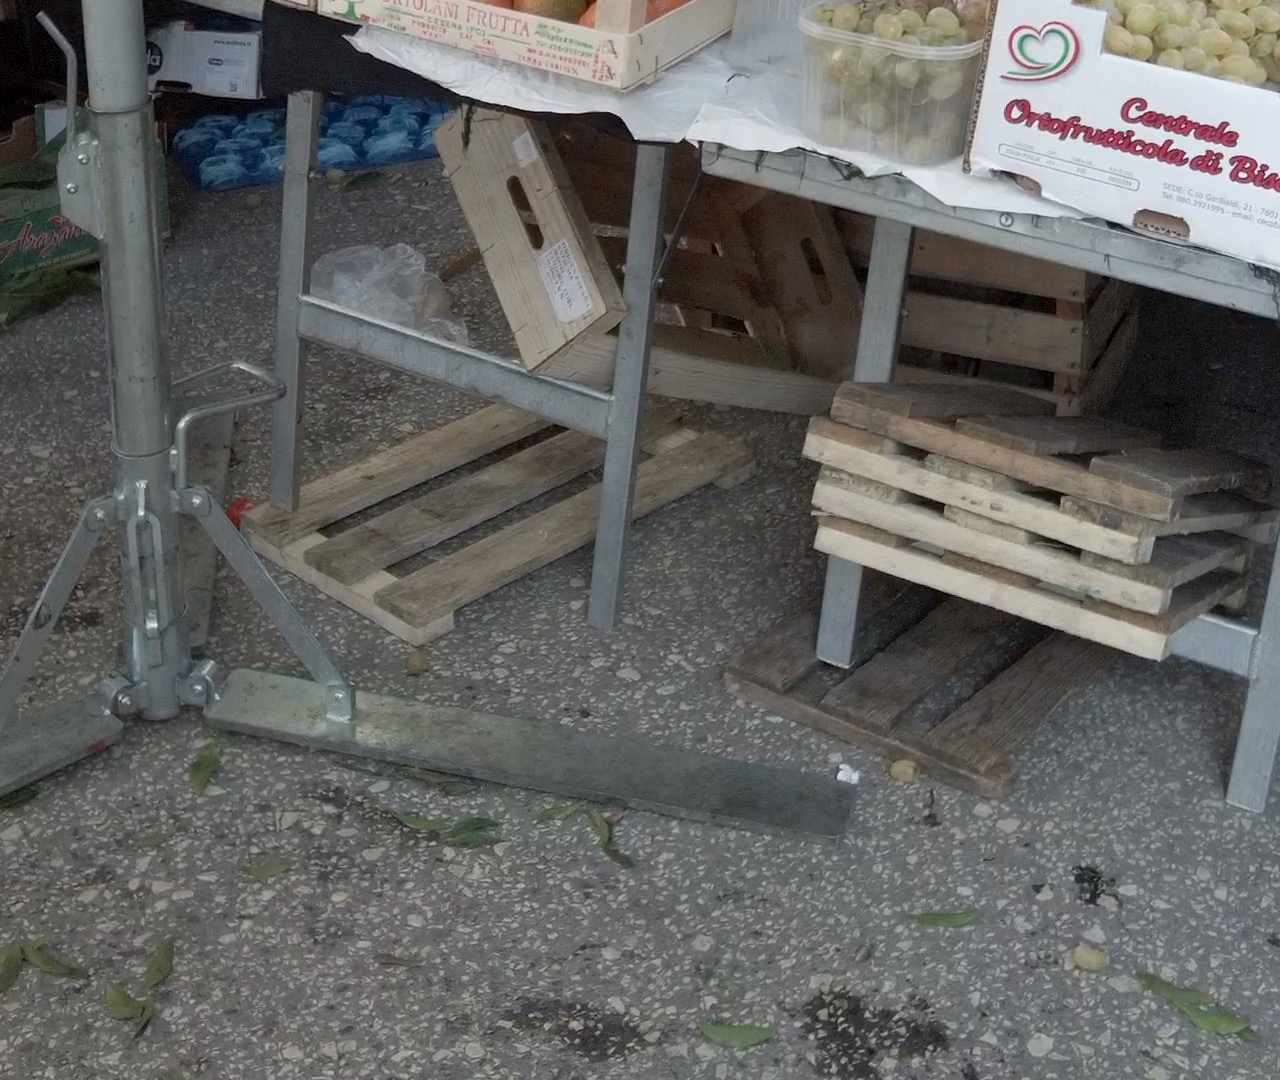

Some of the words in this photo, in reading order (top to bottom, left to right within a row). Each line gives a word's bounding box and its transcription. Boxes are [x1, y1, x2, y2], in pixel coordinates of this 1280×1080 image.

[466, 5, 531, 38] FRUTTA
[1003, 98, 1189, 167] Ortofrutticola
[1189, 149, 1223, 175] di
[1120, 97, 1240, 148] Centrale
